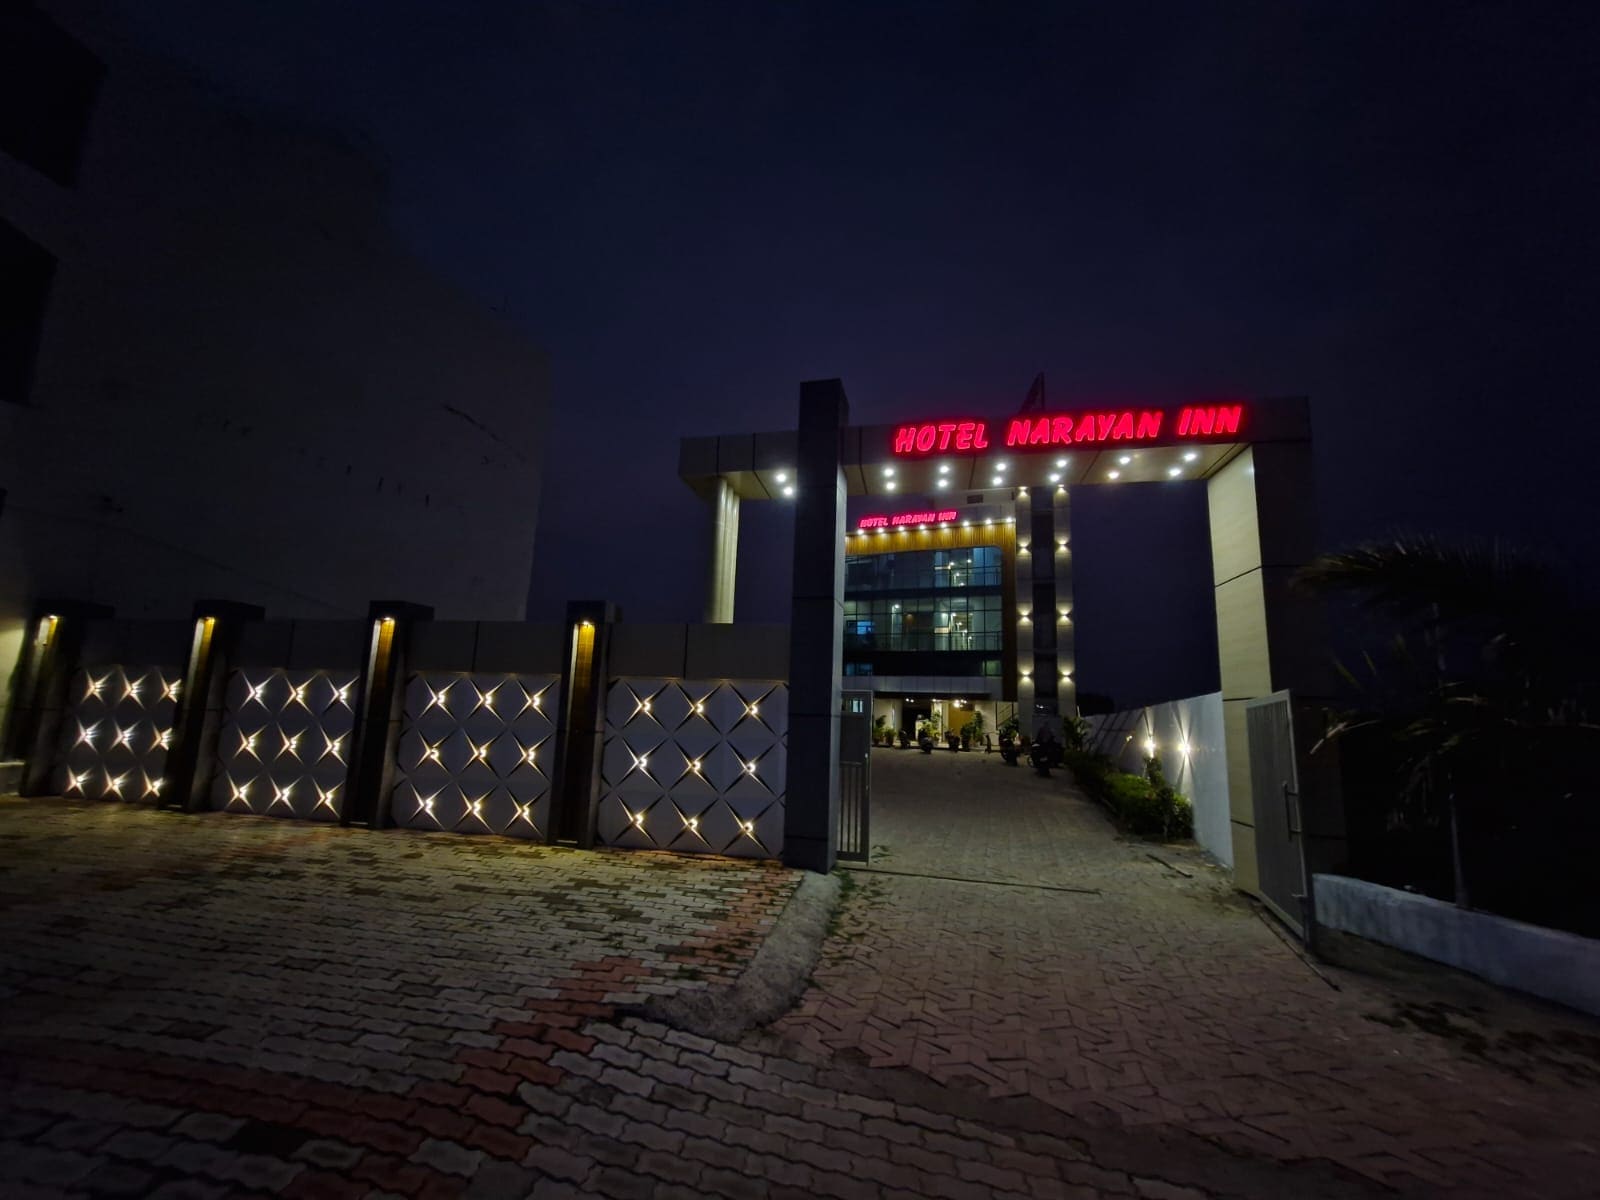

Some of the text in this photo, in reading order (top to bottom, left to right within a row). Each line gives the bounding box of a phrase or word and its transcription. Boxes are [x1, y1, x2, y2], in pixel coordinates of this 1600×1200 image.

[895, 406, 1242, 453] HOTEL NARAYAN INN
[860, 511, 957, 528] HOTEL NARAYAN INN
